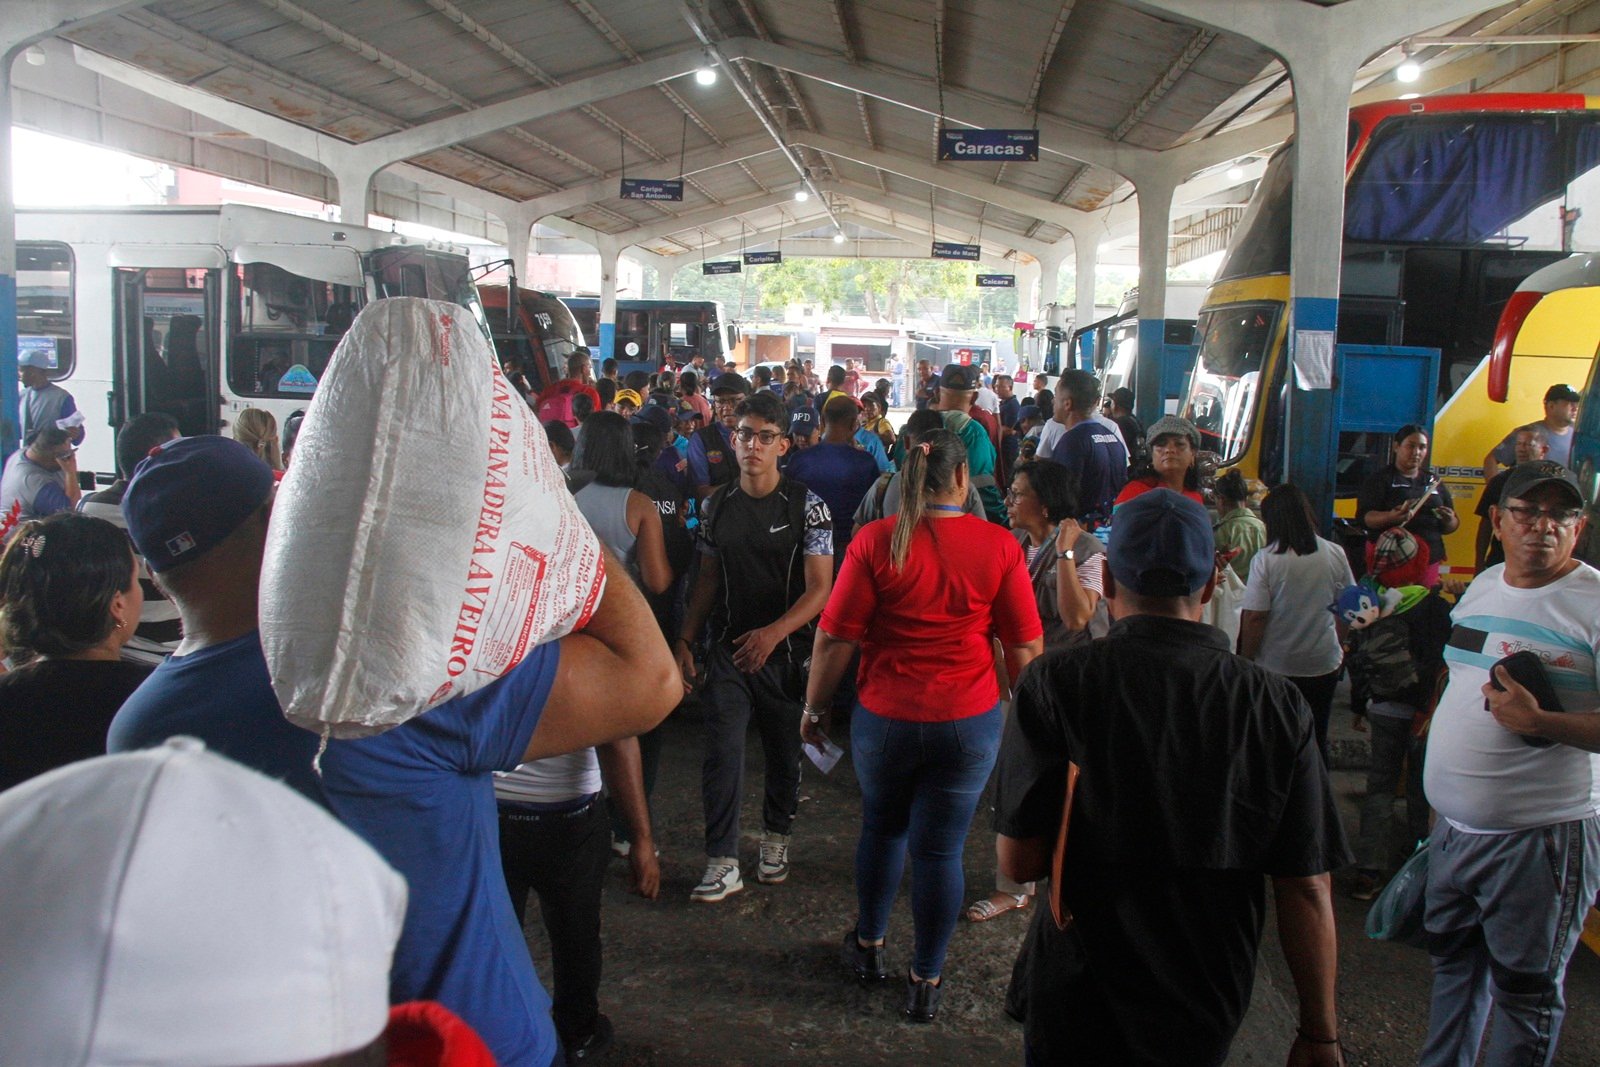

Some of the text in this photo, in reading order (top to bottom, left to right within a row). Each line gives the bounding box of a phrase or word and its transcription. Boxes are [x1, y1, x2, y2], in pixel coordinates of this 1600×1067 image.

[954, 141, 1025, 155] Caracas
[645, 192, 673, 200] Antonio
[792, 412, 811, 422] DPD
[652, 500, 676, 514] NSA
[447, 557, 495, 677] AVEIRO
[513, 578, 543, 664] VALOR NUTRICIONAL
